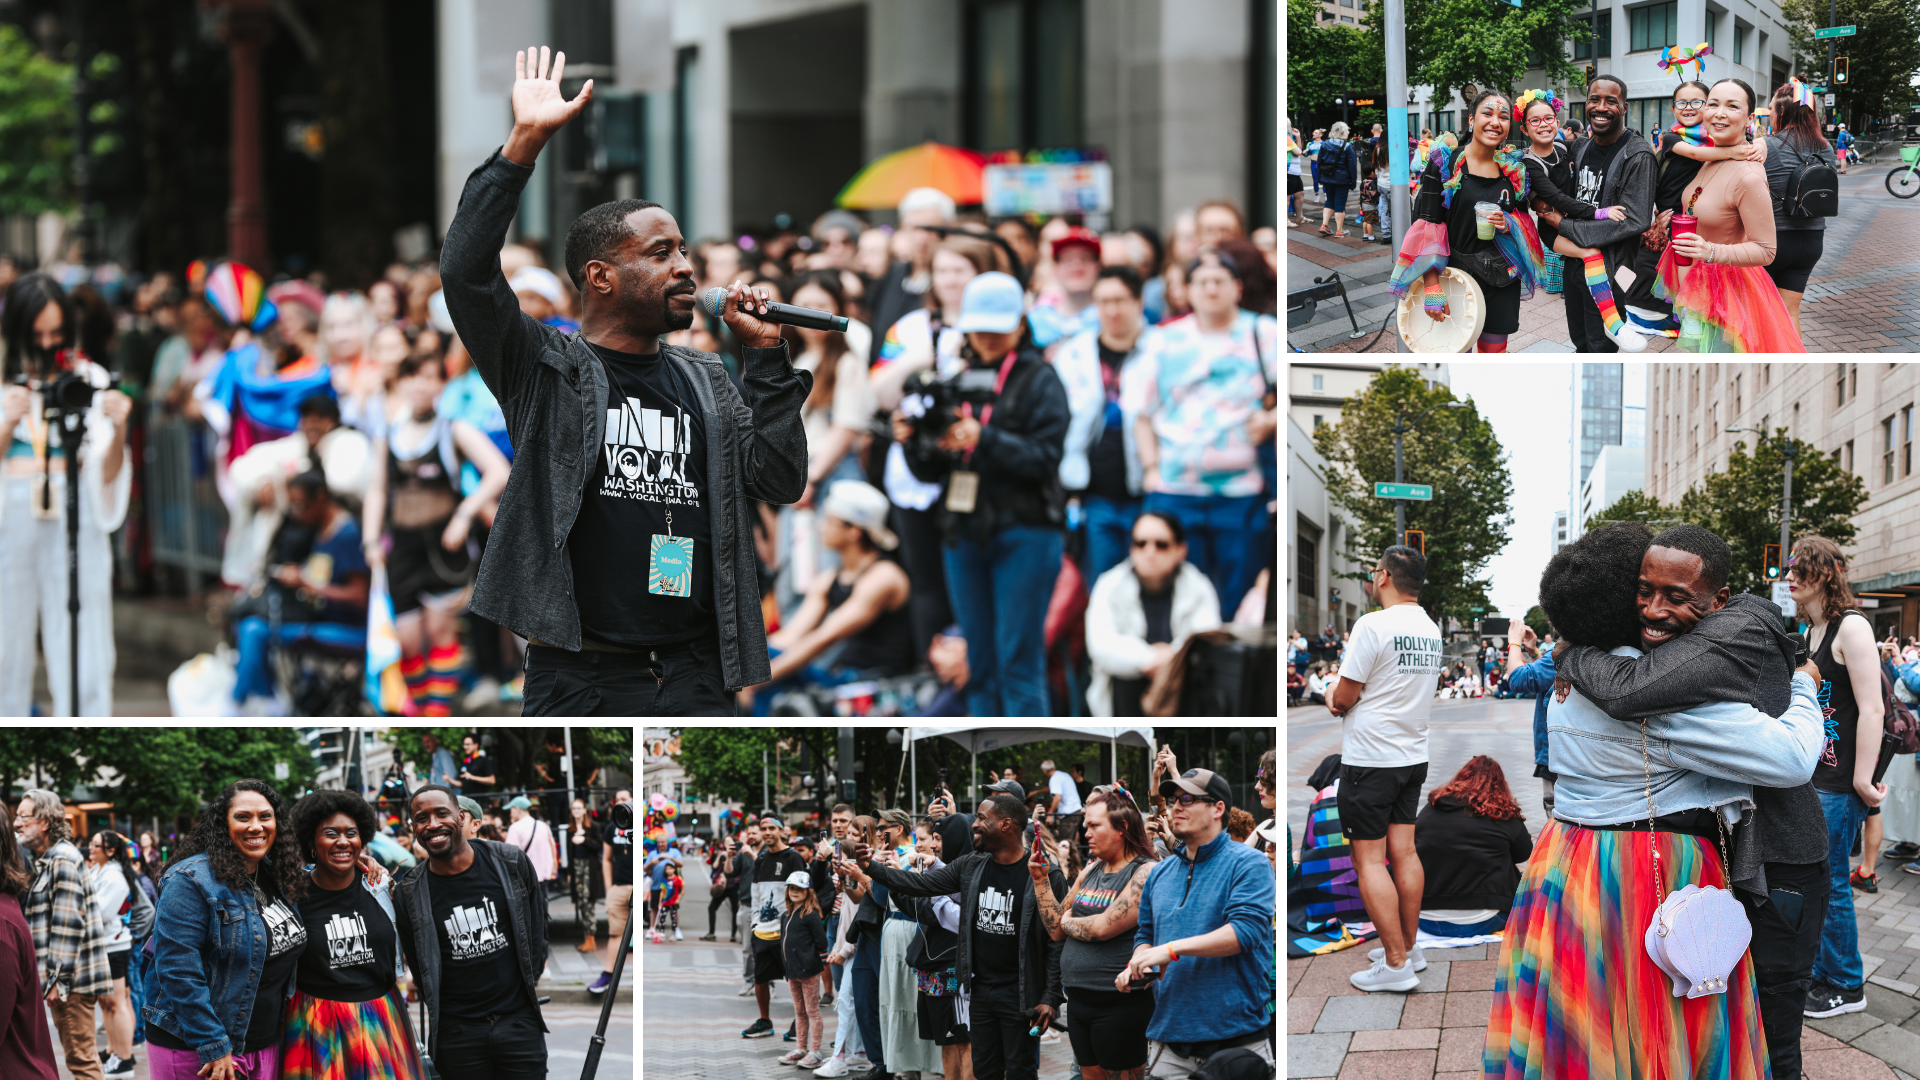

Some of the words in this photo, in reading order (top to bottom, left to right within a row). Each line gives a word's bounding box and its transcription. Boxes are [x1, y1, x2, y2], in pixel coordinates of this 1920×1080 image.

[604, 443, 694, 487] VOCAL
[604, 476, 699, 498] WASHINGTON
[1410, 488, 1425, 497] Ave
[660, 556, 682, 565] Media
[327, 934, 373, 959] VOCAL
[448, 922, 504, 951] VOCAL
[451, 936, 507, 956] WASHINGTON
[329, 951, 374, 965] WASHINGTON
